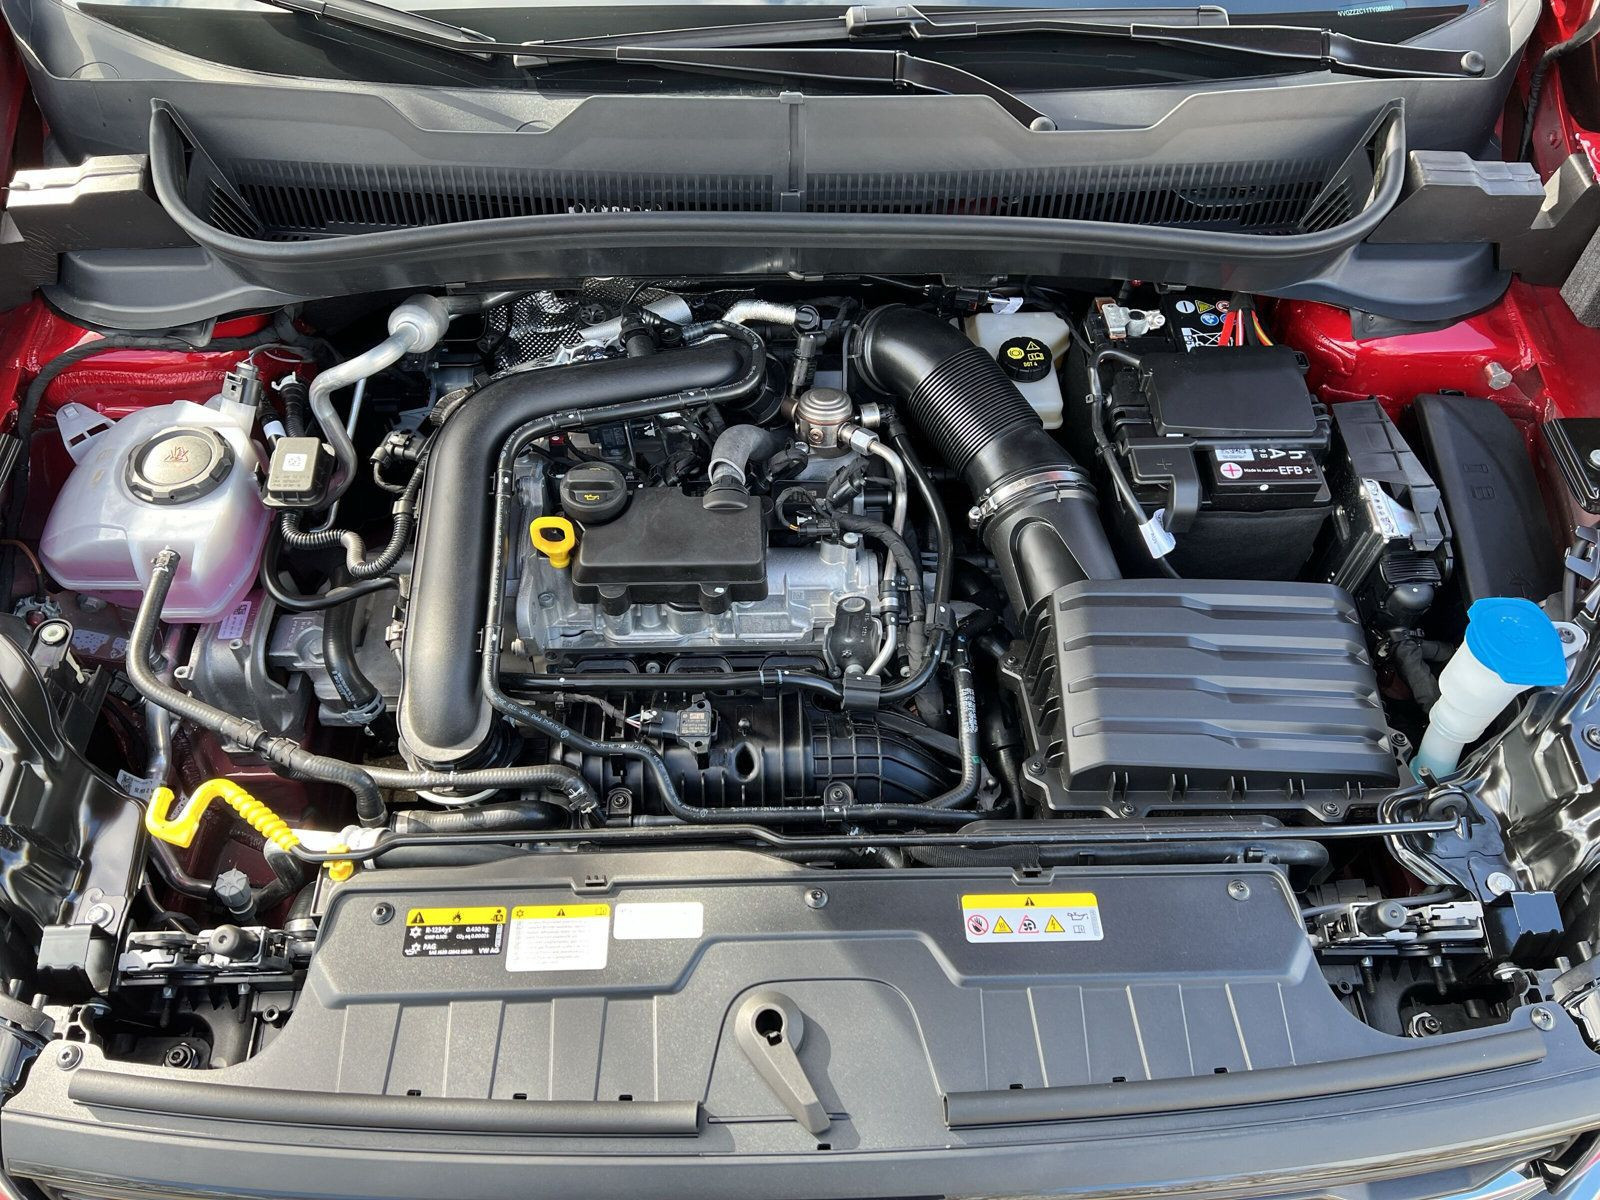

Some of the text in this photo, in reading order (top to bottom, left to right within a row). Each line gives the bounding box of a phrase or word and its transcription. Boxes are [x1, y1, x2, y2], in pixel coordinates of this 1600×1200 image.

[1278, 466, 1304, 475] EFB
[425, 926, 453, 934] R-1234yf
[490, 946, 500, 954] AG
